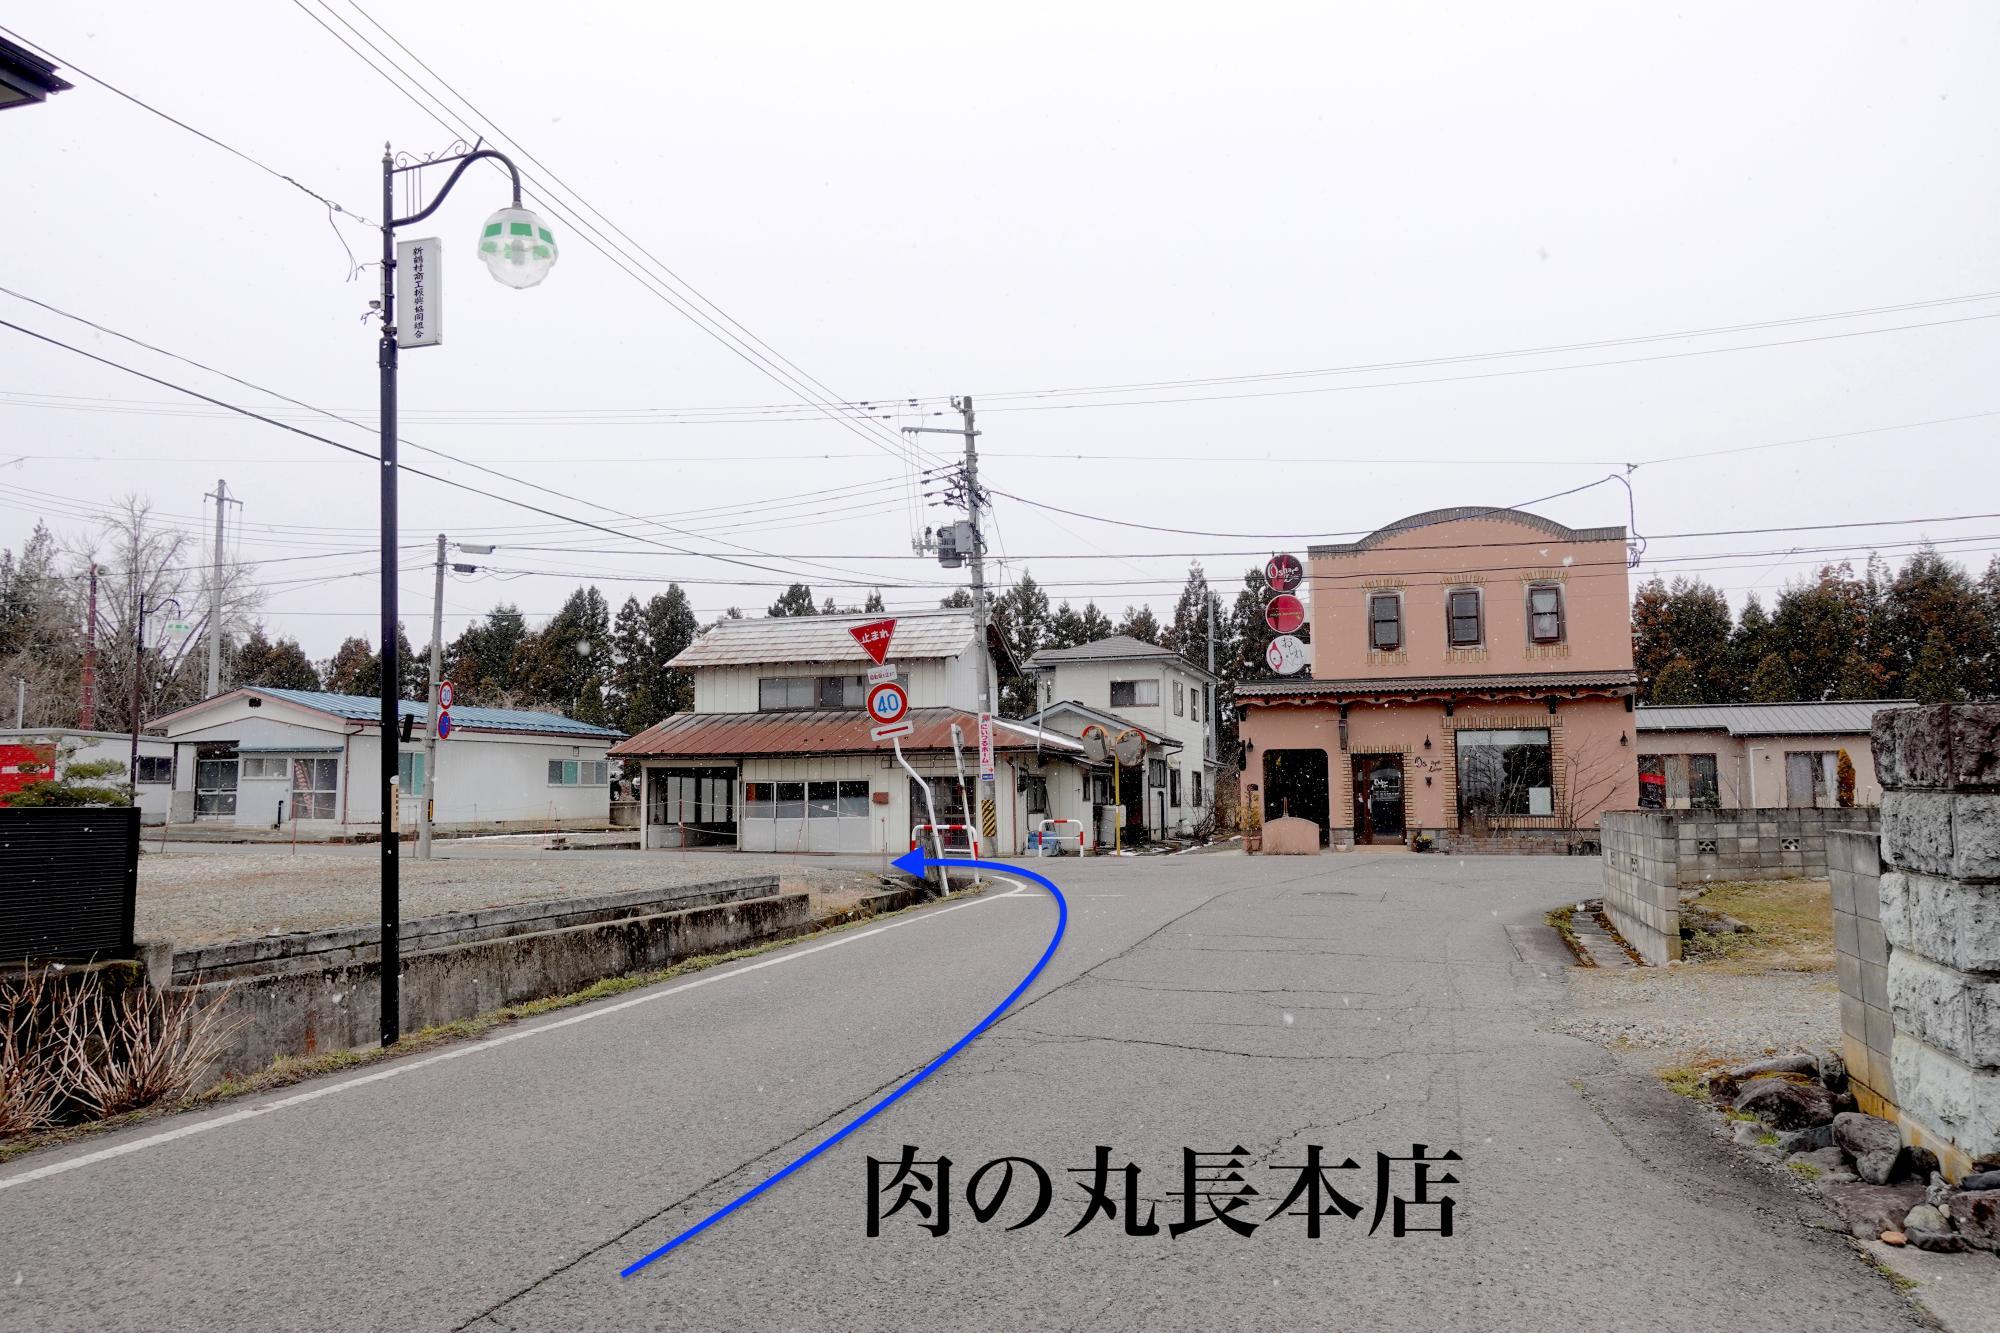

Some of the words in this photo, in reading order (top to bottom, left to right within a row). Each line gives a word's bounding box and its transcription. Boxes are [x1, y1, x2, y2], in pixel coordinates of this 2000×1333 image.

[861, 629, 889, 644] 止まれ
[443, 689, 450, 701] 30
[877, 694, 899, 713] 40
